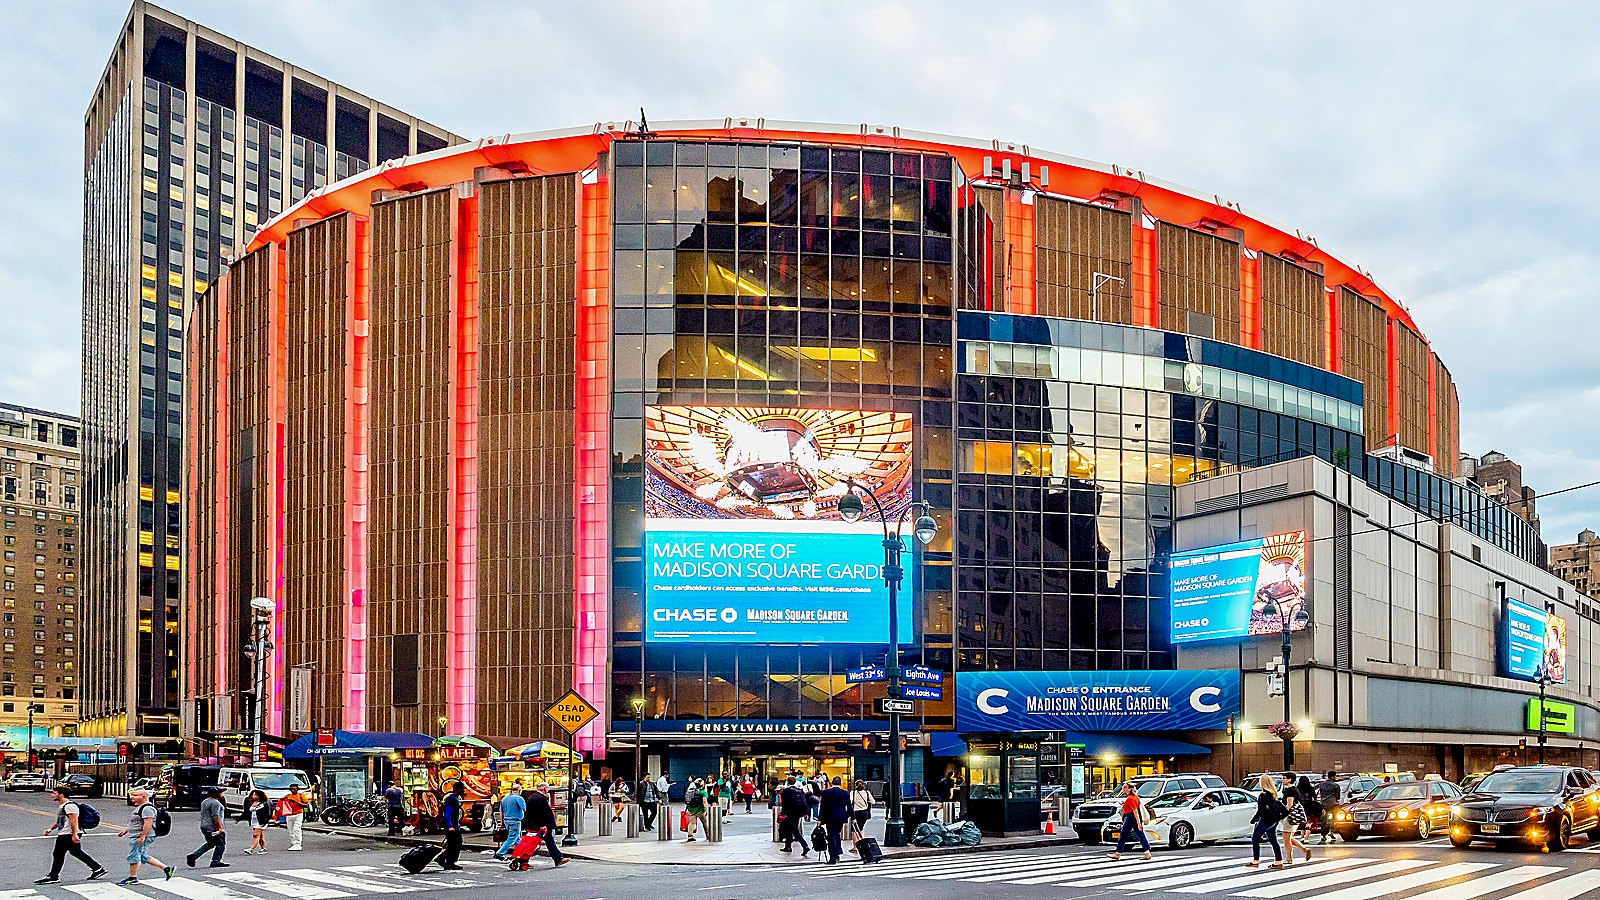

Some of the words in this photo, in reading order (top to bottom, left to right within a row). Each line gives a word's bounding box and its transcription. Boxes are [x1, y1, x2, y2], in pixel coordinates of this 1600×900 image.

[654, 543, 704, 558] MAKE
[711, 544, 766, 558] MORE
[770, 544, 797, 558] OF
[654, 562, 742, 577] MADISON
[747, 563, 822, 580] SQUARE
[827, 564, 885, 580] GARDE
[1174, 584, 1202, 592] MADISON
[1202, 580, 1226, 589] SQUARE
[1227, 576, 1252, 585] GARDEN
[653, 609, 717, 622] CHASE
[747, 609, 783, 621] MADISON
[785, 609, 816, 621] SQUARE
[1174, 619, 1200, 628] CHASE
[906, 670, 926, 679] Eighth
[977, 688, 1009, 714] C
[1027, 696, 1077, 711] MADISON
[1081, 696, 1122, 712] SQUARE
[1190, 686, 1221, 712] C
[686, 724, 789, 732] PENNSYLVANIA
[795, 724, 849, 732] STATION
[406, 750, 414, 758] HOT
[416, 750, 424, 758] DOG
[440, 749, 477, 758] ALAFEL
